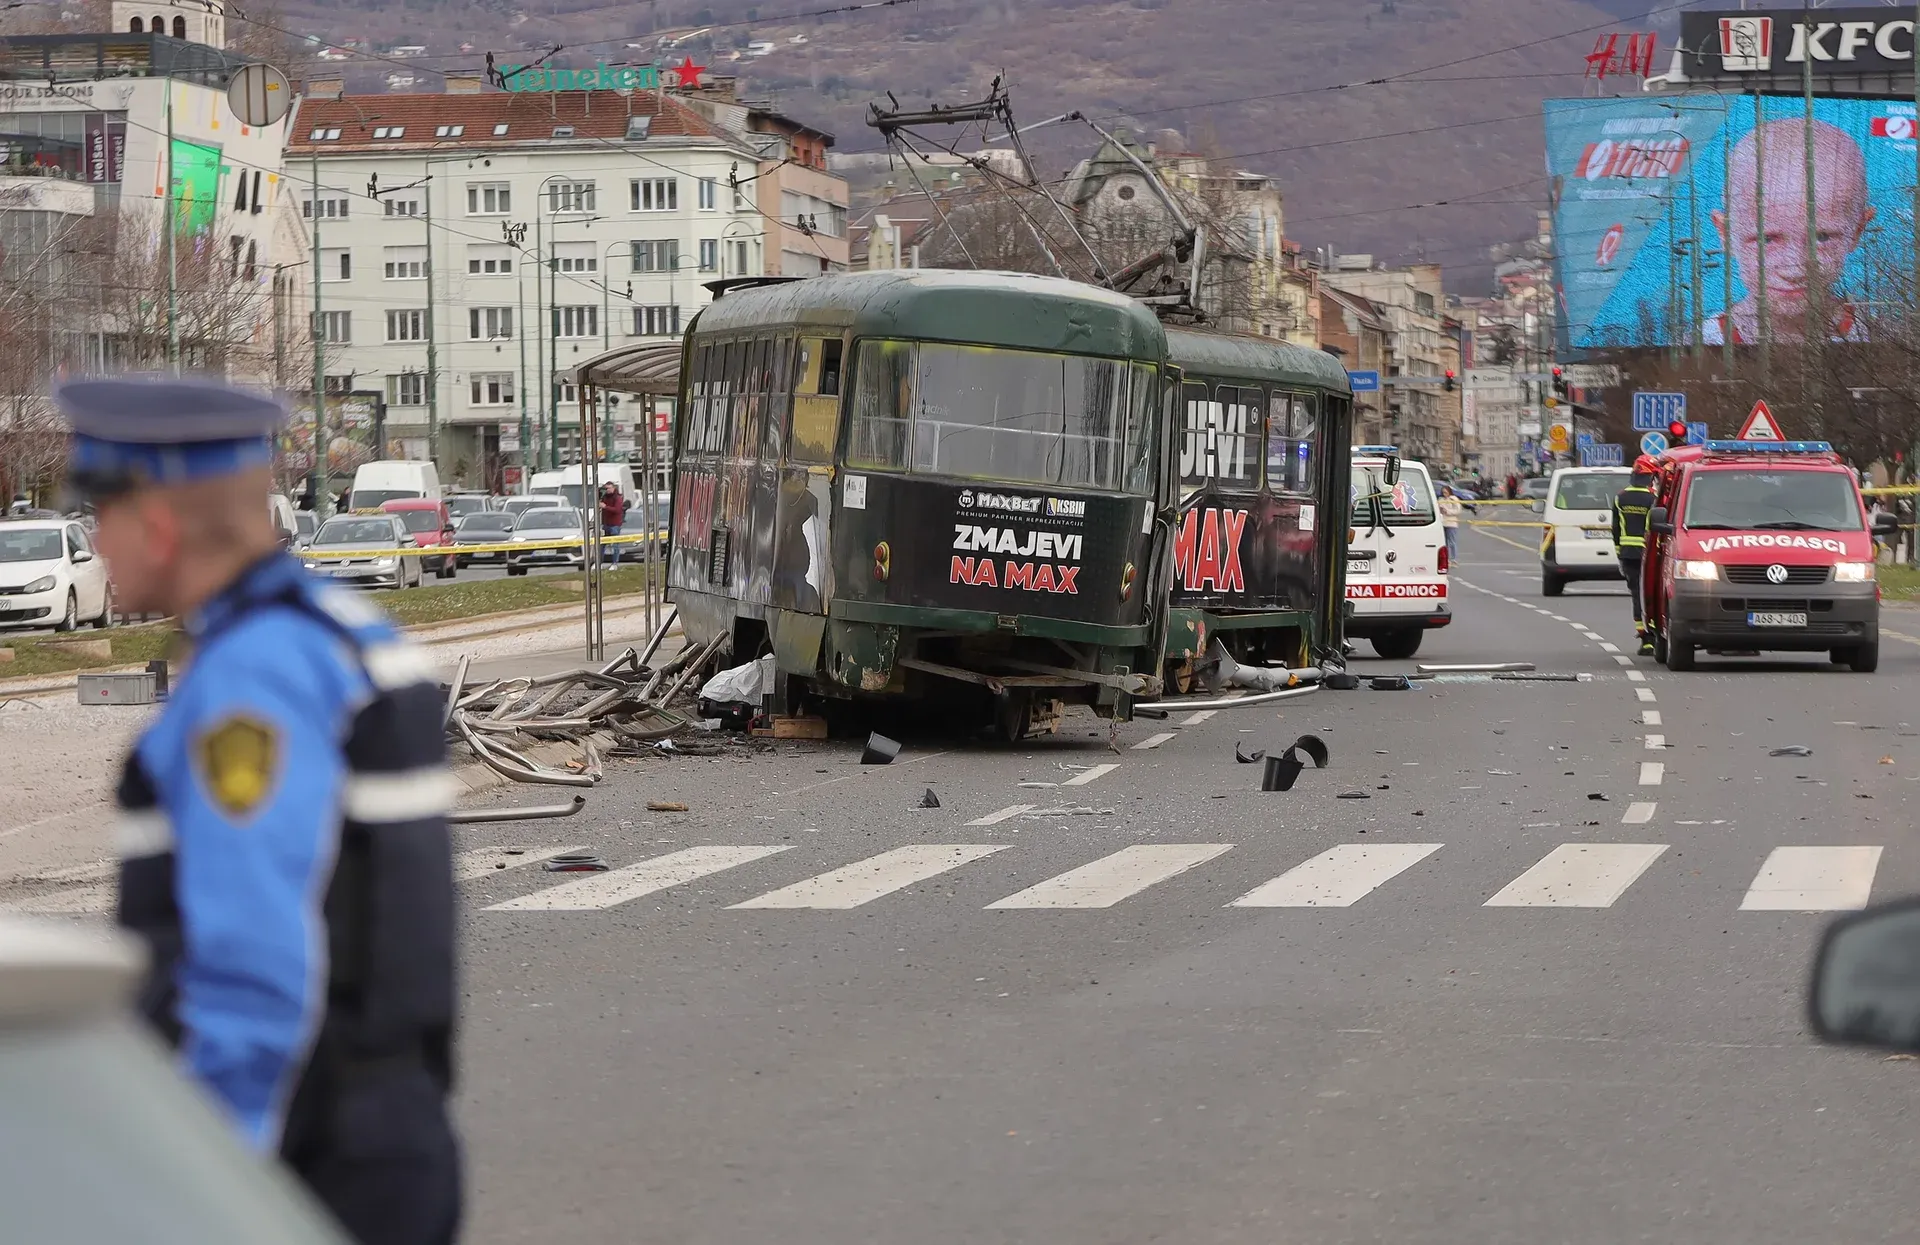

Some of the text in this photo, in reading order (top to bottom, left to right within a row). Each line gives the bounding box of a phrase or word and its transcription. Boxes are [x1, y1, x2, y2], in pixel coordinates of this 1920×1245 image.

[1785, 20, 1915, 62] KFC
[956, 510, 1084, 527] PREMIUM PARTNER REPREZENTACIJE
[1056, 499, 1086, 515] KSBIH
[953, 524, 1083, 560] ZMAJEVI
[1169, 507, 1249, 593] MAX
[1698, 535, 1847, 556] VATROGASCI
[950, 555, 1081, 594] NA MAX
[1754, 613, 1806, 625] A68-J-403
